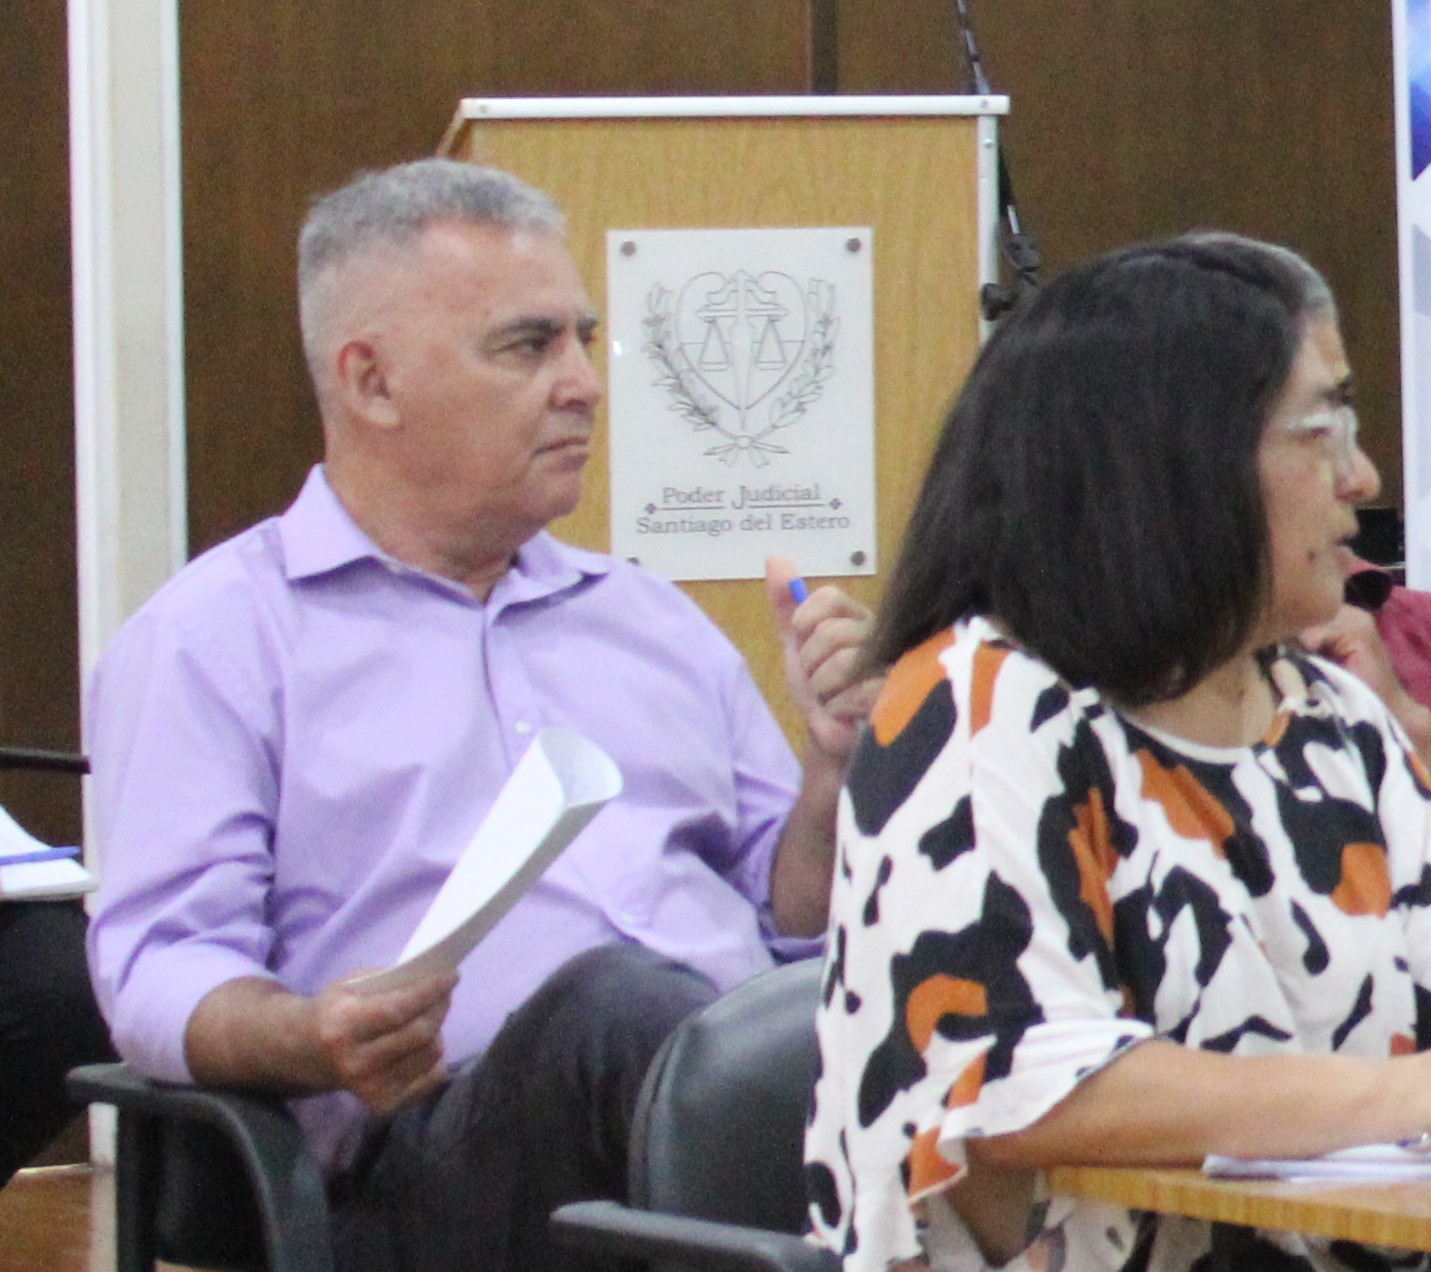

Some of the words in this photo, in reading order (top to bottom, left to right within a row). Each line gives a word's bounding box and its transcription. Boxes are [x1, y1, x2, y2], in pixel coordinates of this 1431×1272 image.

[662, 486, 726, 504] Poder
[731, 483, 821, 510] Judicial
[636, 515, 733, 536] Santiago
[740, 514, 773, 530] del
[780, 513, 850, 531] Estero
